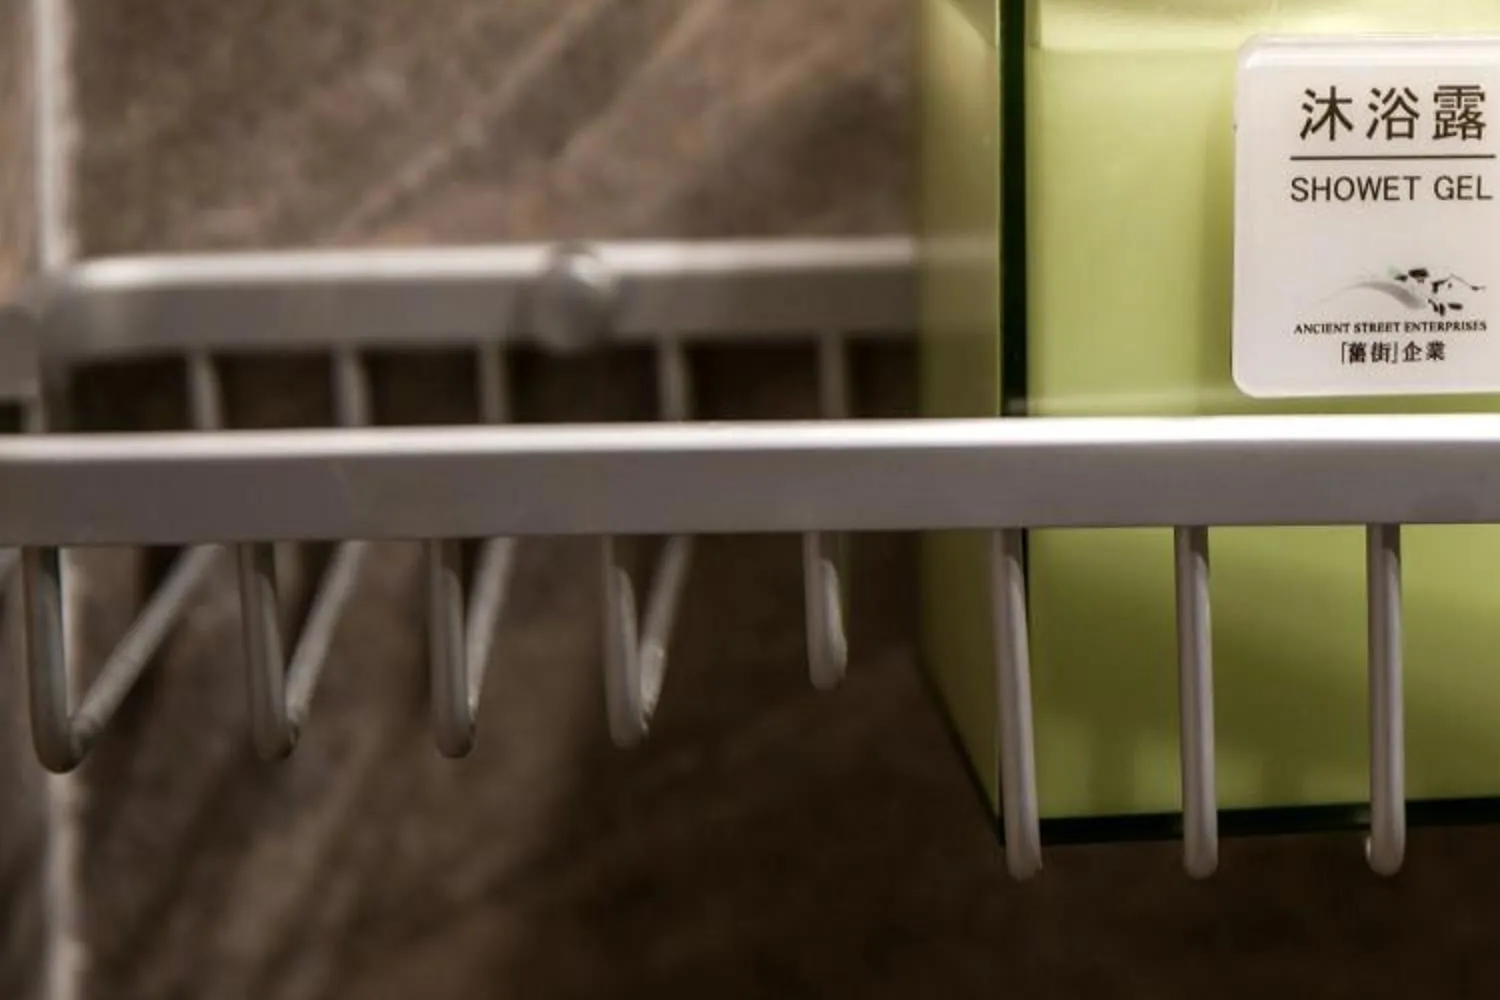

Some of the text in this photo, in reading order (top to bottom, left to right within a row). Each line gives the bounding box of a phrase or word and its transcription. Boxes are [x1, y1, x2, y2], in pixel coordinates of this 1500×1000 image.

[1299, 85, 1487, 142] 沐浴露
[1290, 174, 1494, 203] SHOWET GEL
[1293, 320, 1488, 335] ANCIENT STREET ENTERPRISES
